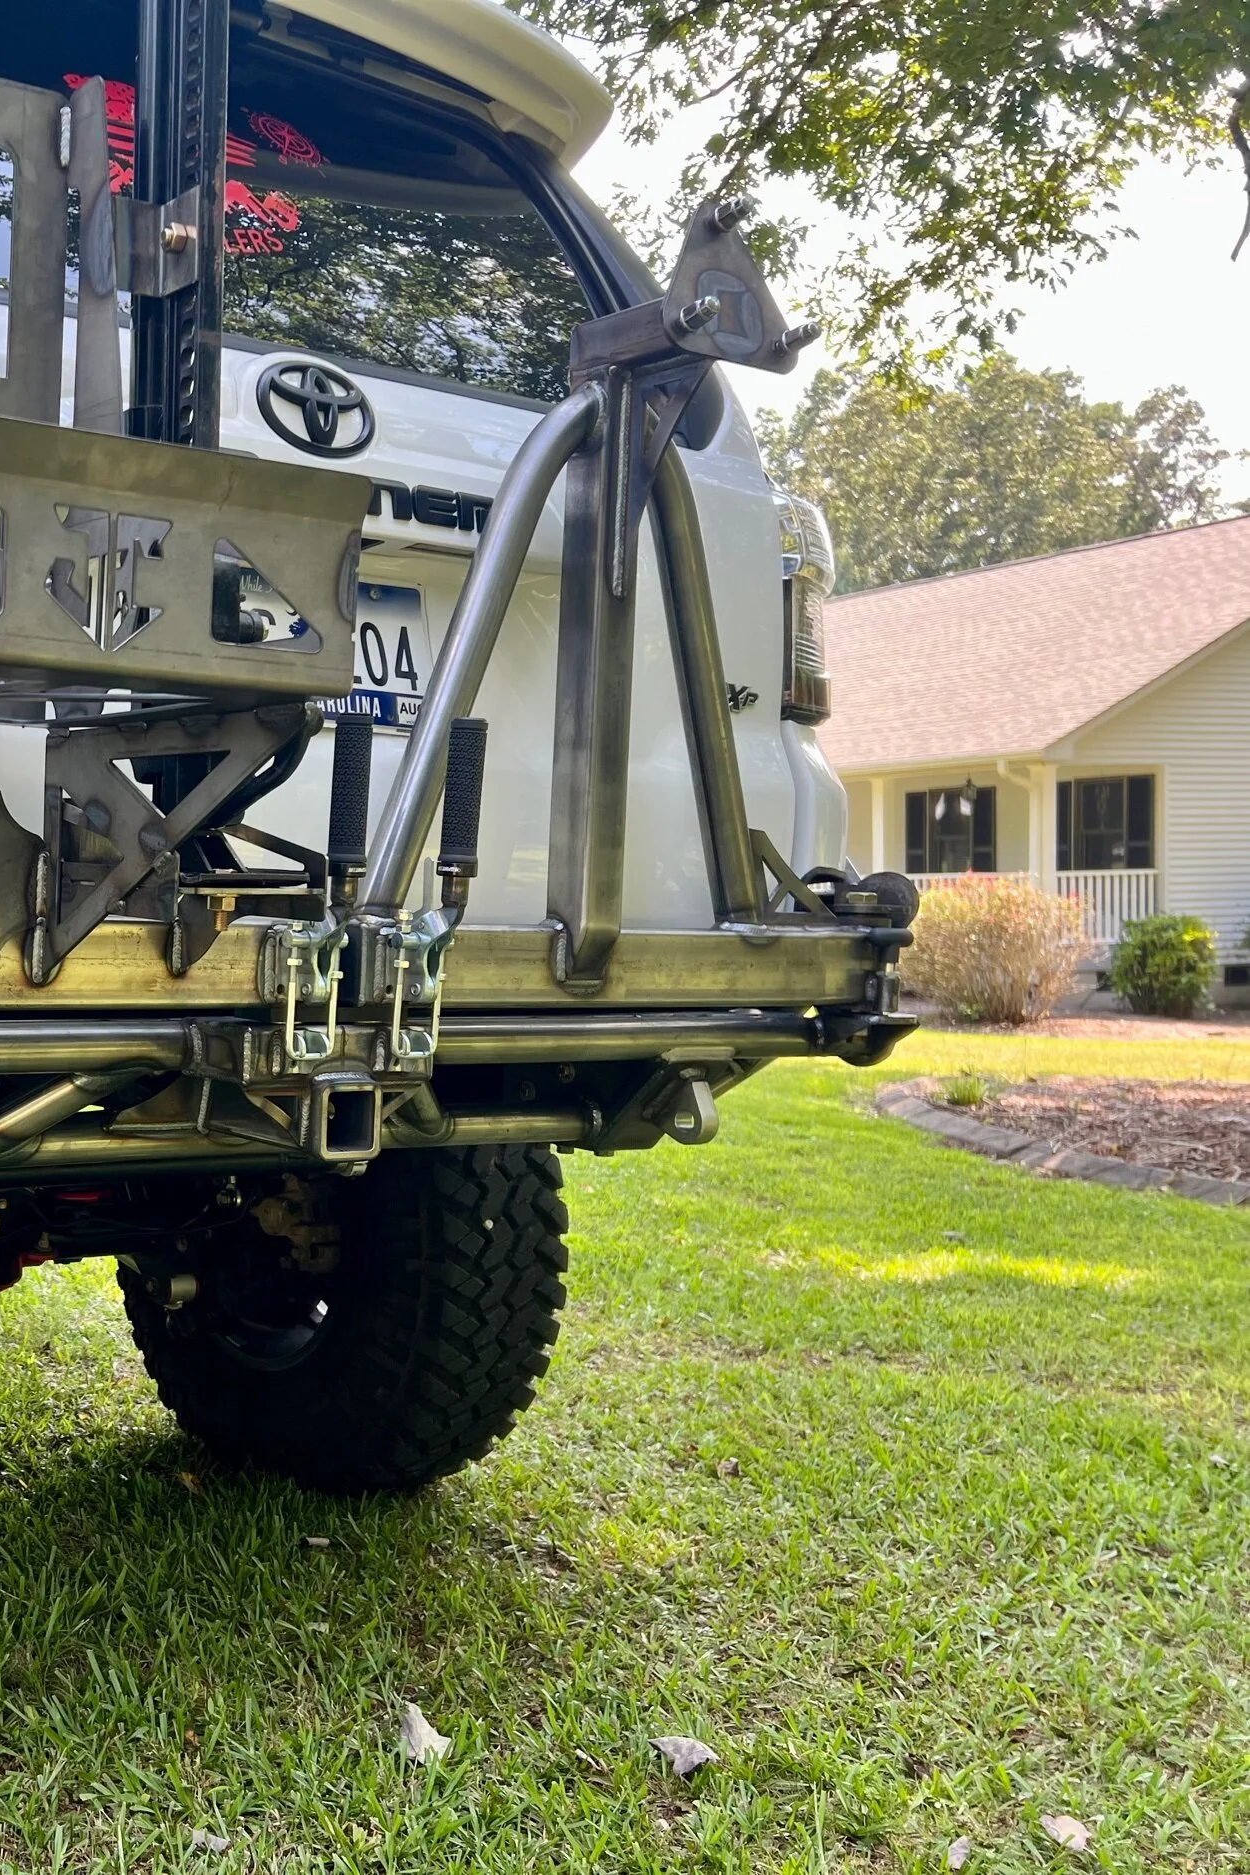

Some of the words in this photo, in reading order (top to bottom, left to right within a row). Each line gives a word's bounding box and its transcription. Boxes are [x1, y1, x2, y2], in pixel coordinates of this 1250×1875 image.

[223, 228, 284, 254] LERS
[353, 622, 419, 692] 04
[316, 695, 382, 718] AROLINA
